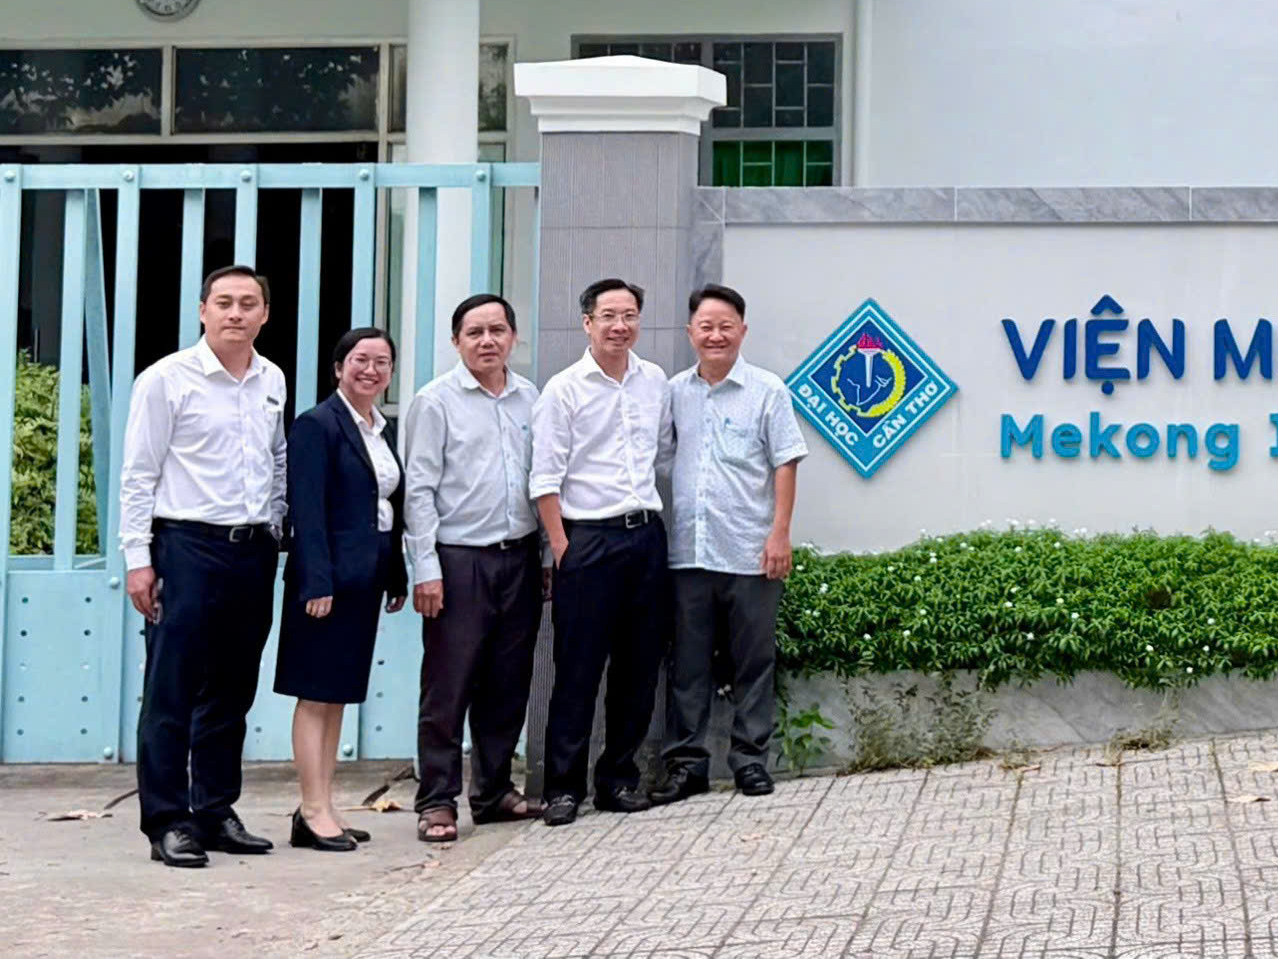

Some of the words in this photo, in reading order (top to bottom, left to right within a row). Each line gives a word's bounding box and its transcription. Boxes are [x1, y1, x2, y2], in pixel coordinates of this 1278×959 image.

[1001, 295, 1186, 396] VIỆN
[825, 411, 859, 446] HỌC
[1000, 411, 1240, 472] Mekong
